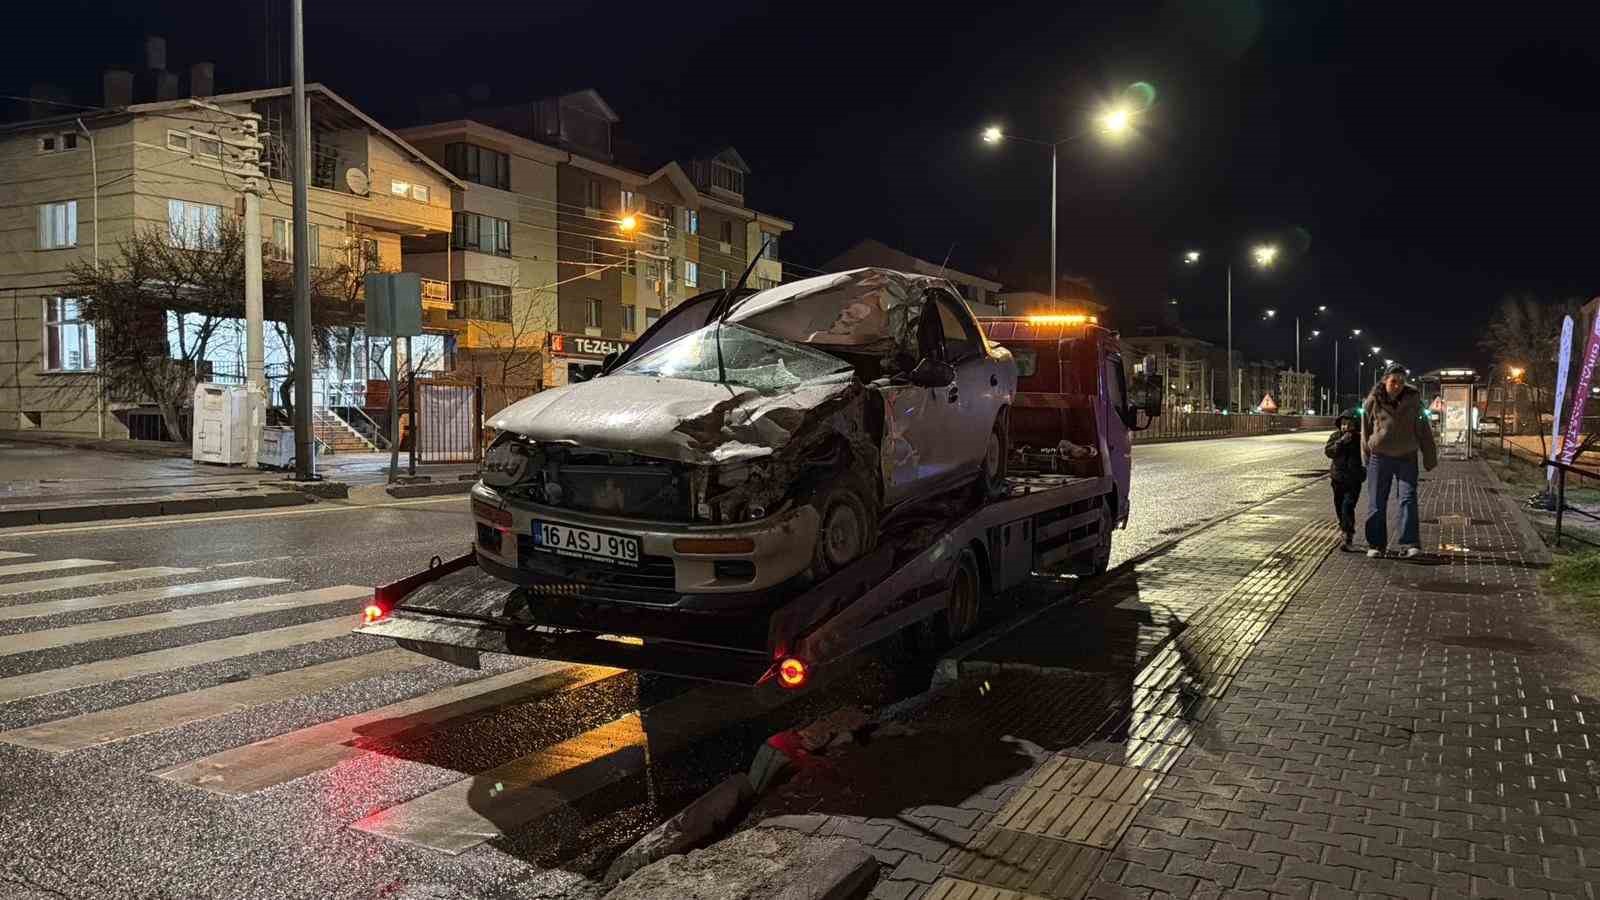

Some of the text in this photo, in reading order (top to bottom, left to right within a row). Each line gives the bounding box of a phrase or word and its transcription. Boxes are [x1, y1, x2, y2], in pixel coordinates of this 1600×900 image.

[543, 525, 560, 546] 16
[566, 529, 602, 552] ASJ
[608, 537, 637, 559] 919
